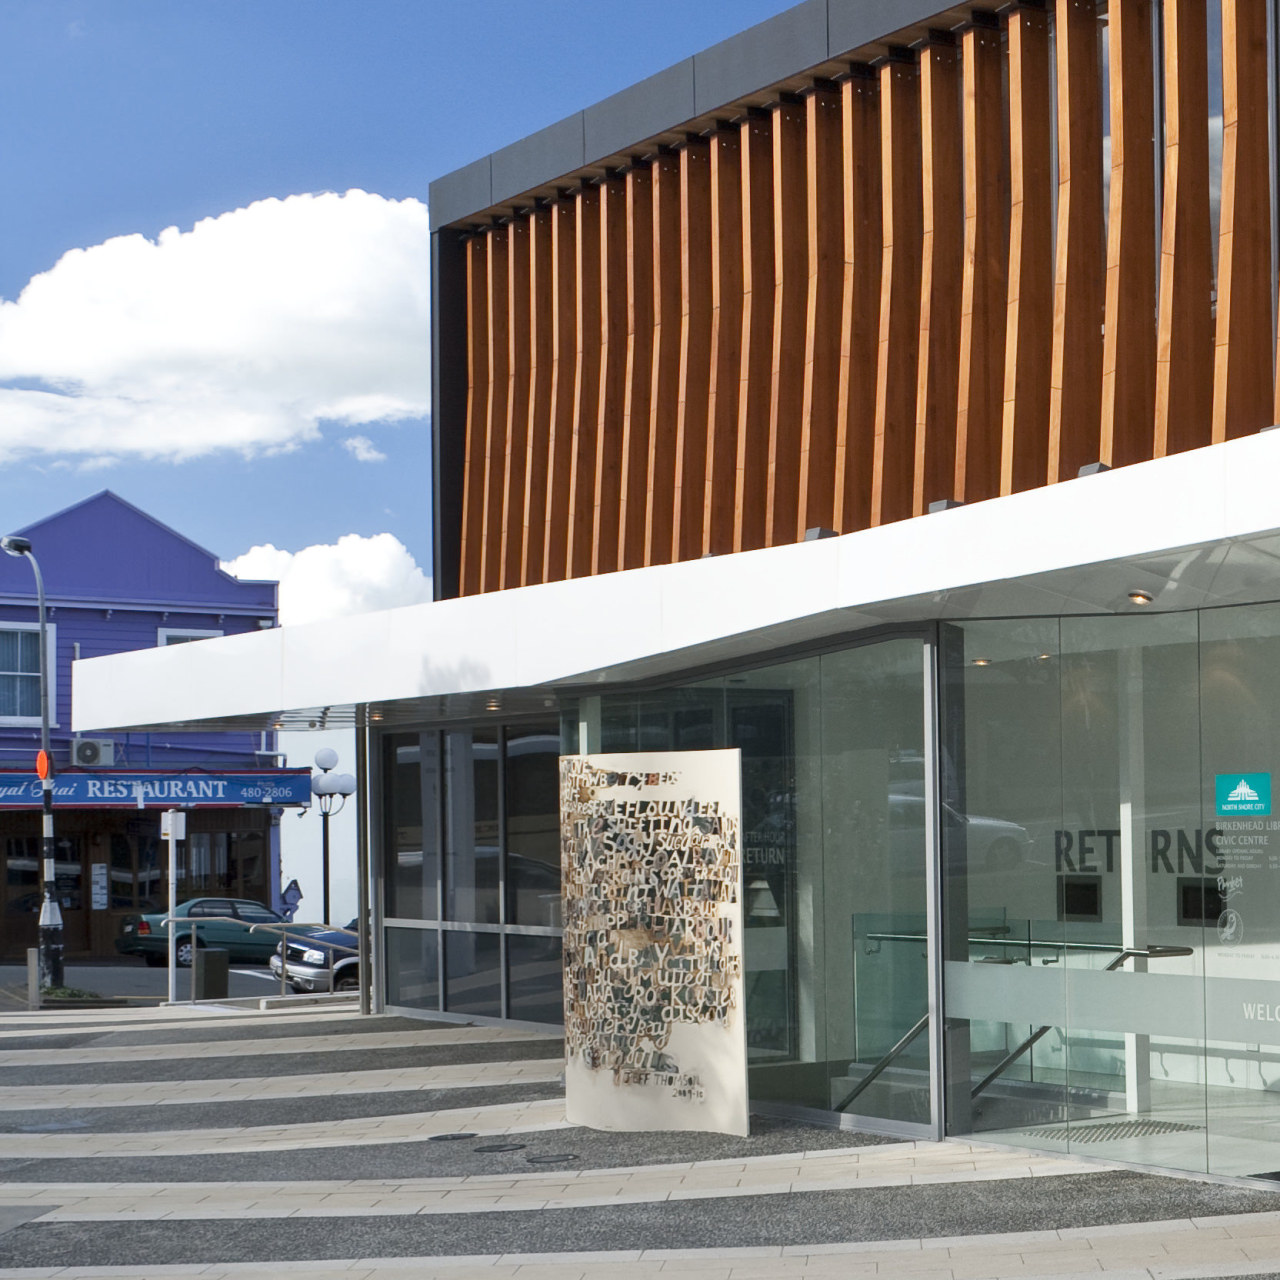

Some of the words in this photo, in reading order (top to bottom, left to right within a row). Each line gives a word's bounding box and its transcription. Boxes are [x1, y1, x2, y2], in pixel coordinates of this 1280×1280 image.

[87, 780, 228, 798] RESTAURANT
[240, 787, 293, 798] 480-2806
[1215, 821, 1264, 831] BIRKENHEAD
[1215, 835, 1237, 845] CIVIC
[1238, 835, 1269, 845] CENTRE
[1054, 828, 1226, 875] RETRNS
[623, 1071, 650, 1084] JEFF
